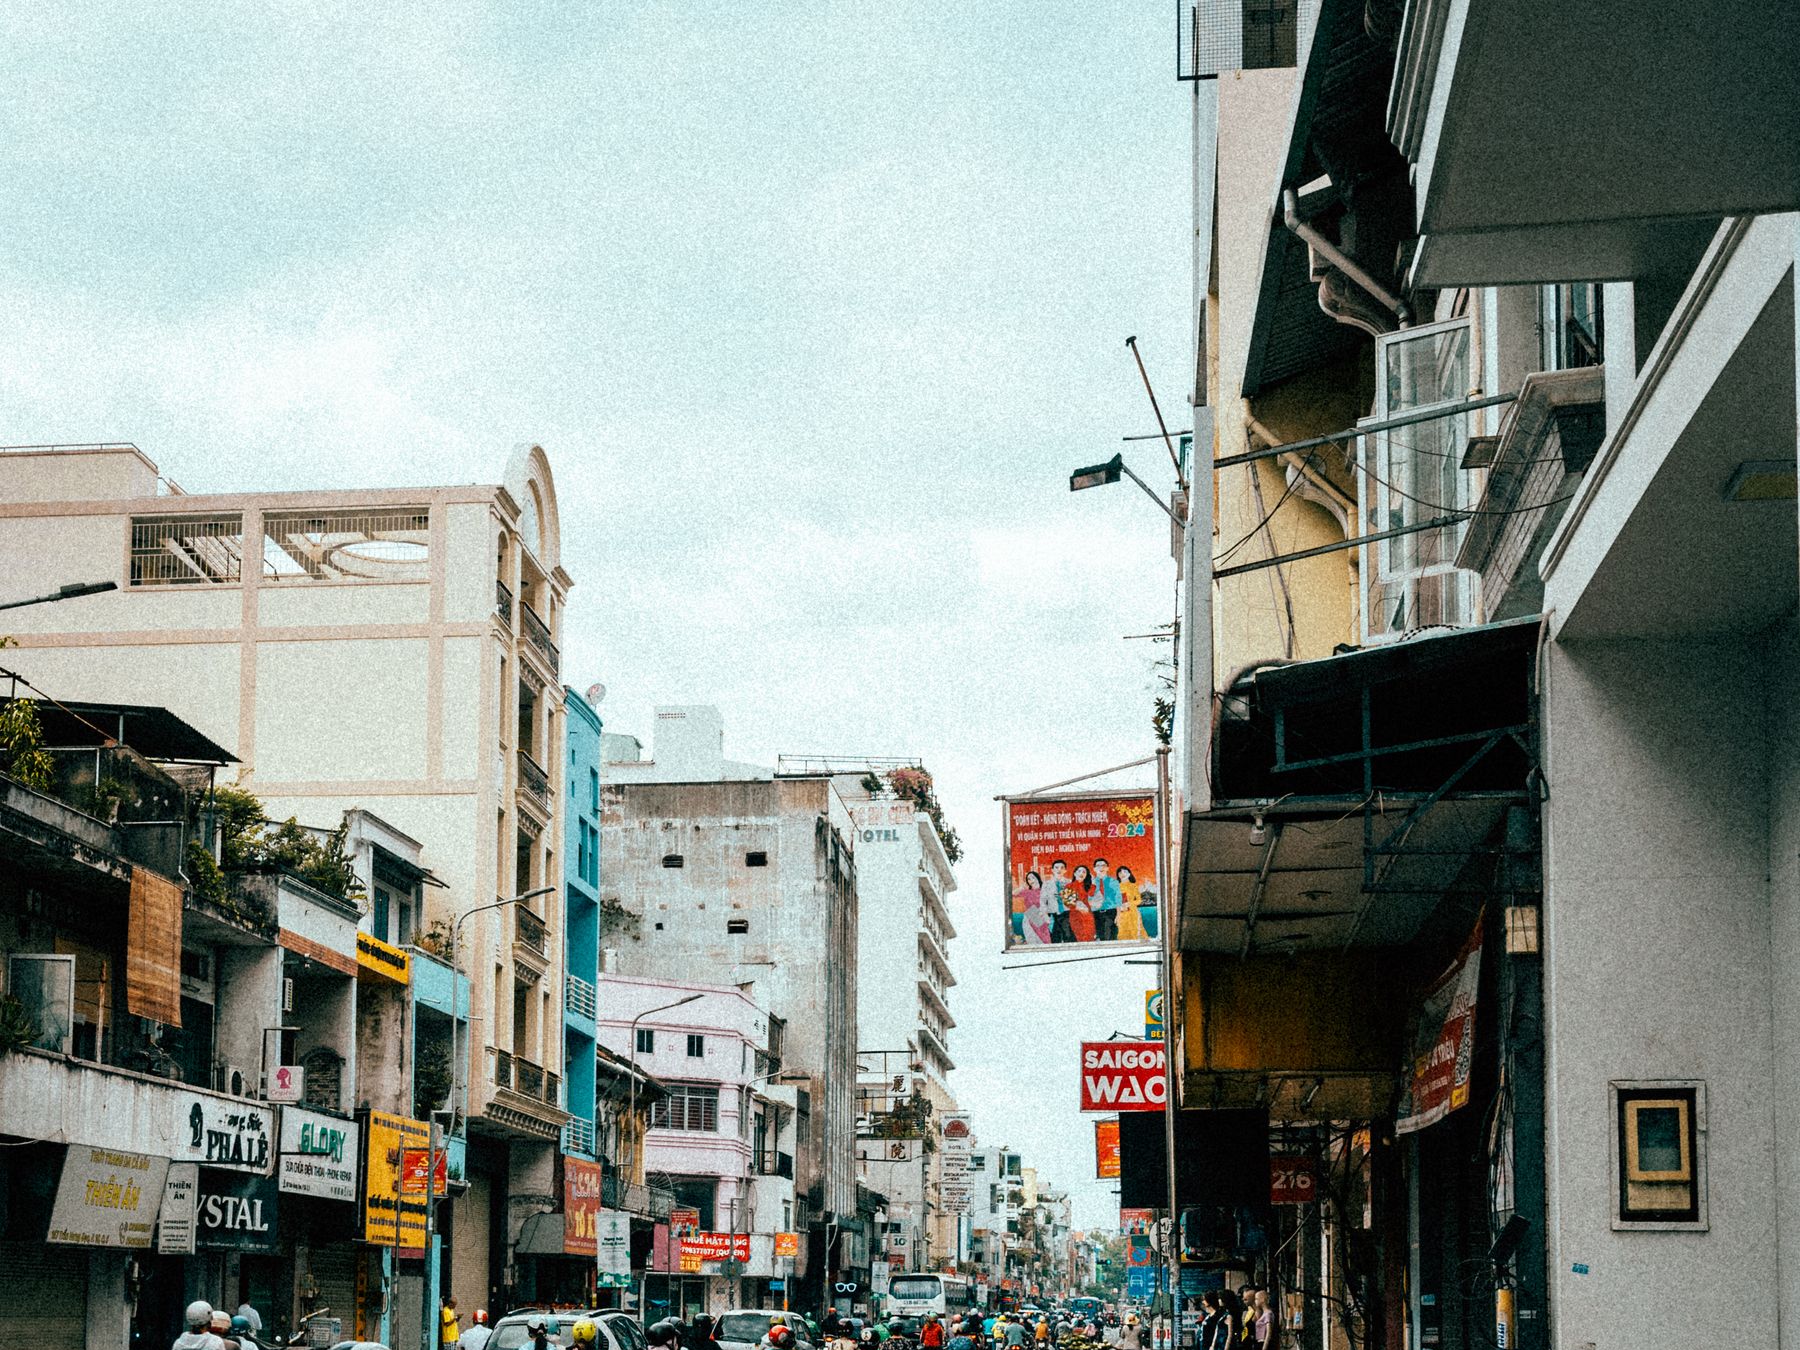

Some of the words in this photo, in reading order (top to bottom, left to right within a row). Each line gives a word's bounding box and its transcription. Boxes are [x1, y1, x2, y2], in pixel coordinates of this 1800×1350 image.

[1107, 823, 1145, 838] 2024
[1084, 1050, 1167, 1070] SAIGON
[1084, 1075, 1167, 1104] WAO
[206, 1129, 244, 1165] PHA
[246, 1132, 269, 1168] LÊ
[301, 1120, 346, 1163] GLORY
[84, 1174, 123, 1209] THIÊN
[120, 1176, 141, 1211] ÂN
[168, 1181, 192, 1190] THIÊN
[173, 1191, 185, 1200] ÂN
[724, 1237, 748, 1246] BNG
[716, 1248, 746, 1258] (QUÊN)
